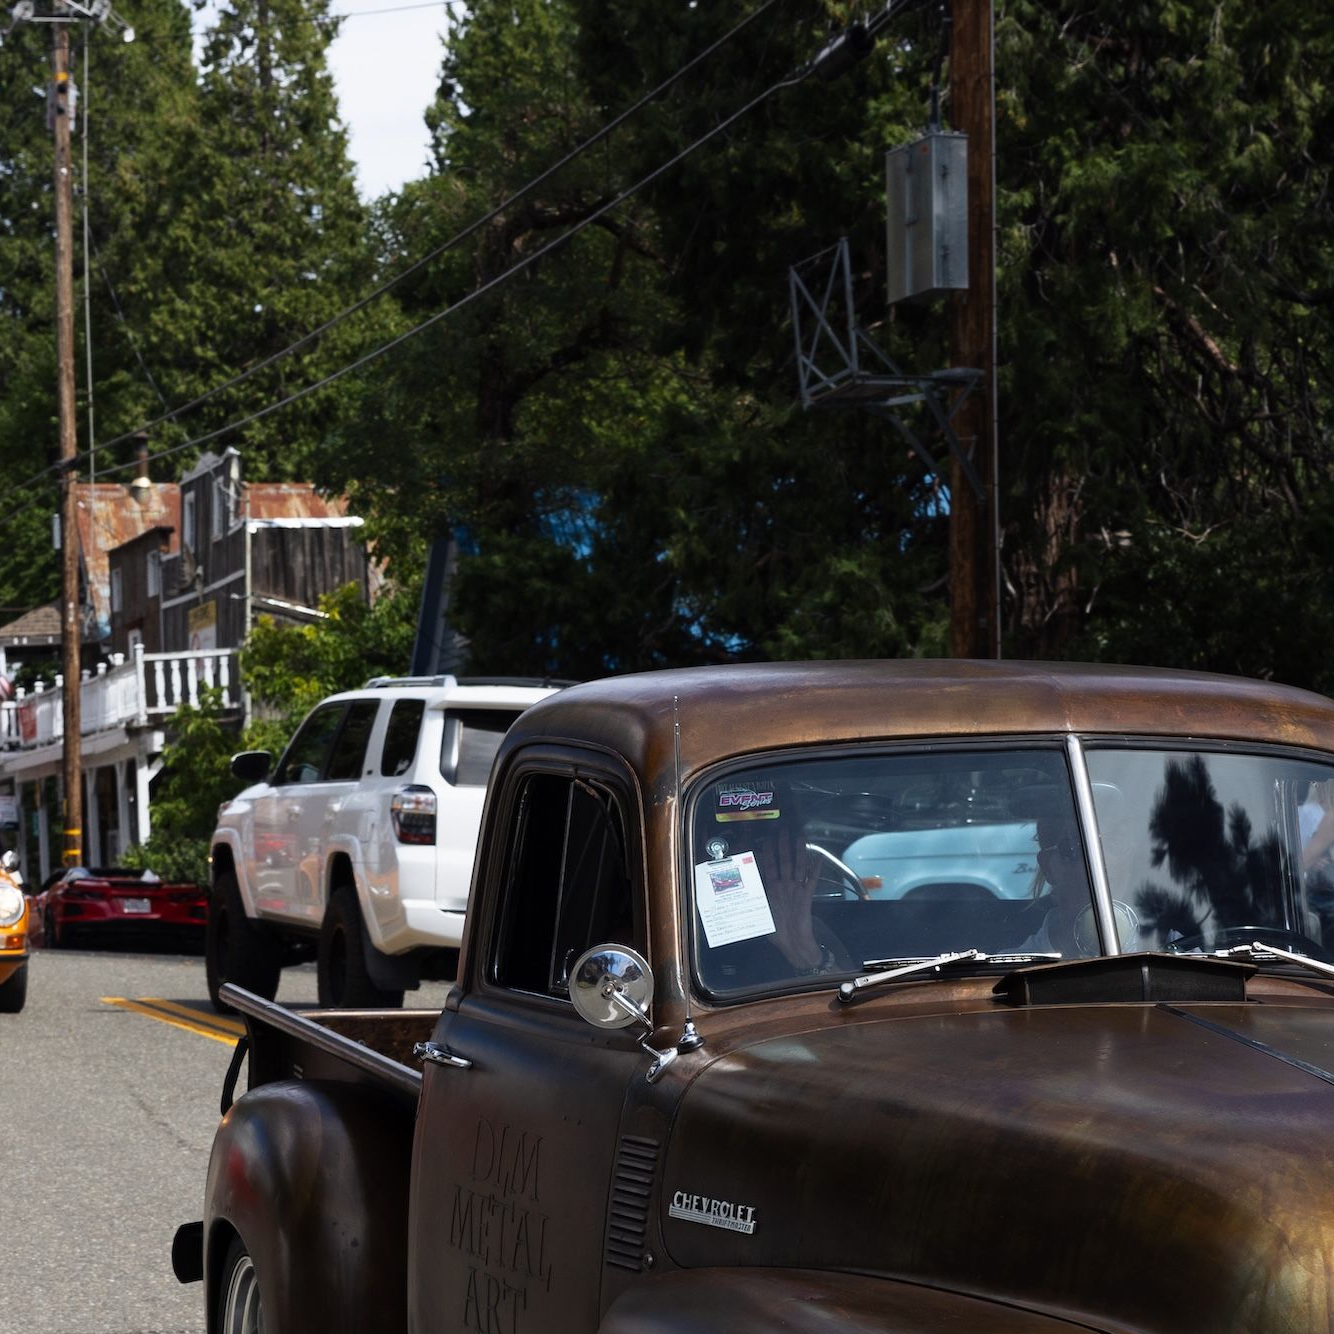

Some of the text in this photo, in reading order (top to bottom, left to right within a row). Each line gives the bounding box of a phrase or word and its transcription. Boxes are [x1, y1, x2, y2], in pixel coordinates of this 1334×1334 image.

[719, 792, 773, 807] EVENT
[673, 1191, 756, 1224] CHEVROLET
[448, 1184, 552, 1293] METAL
